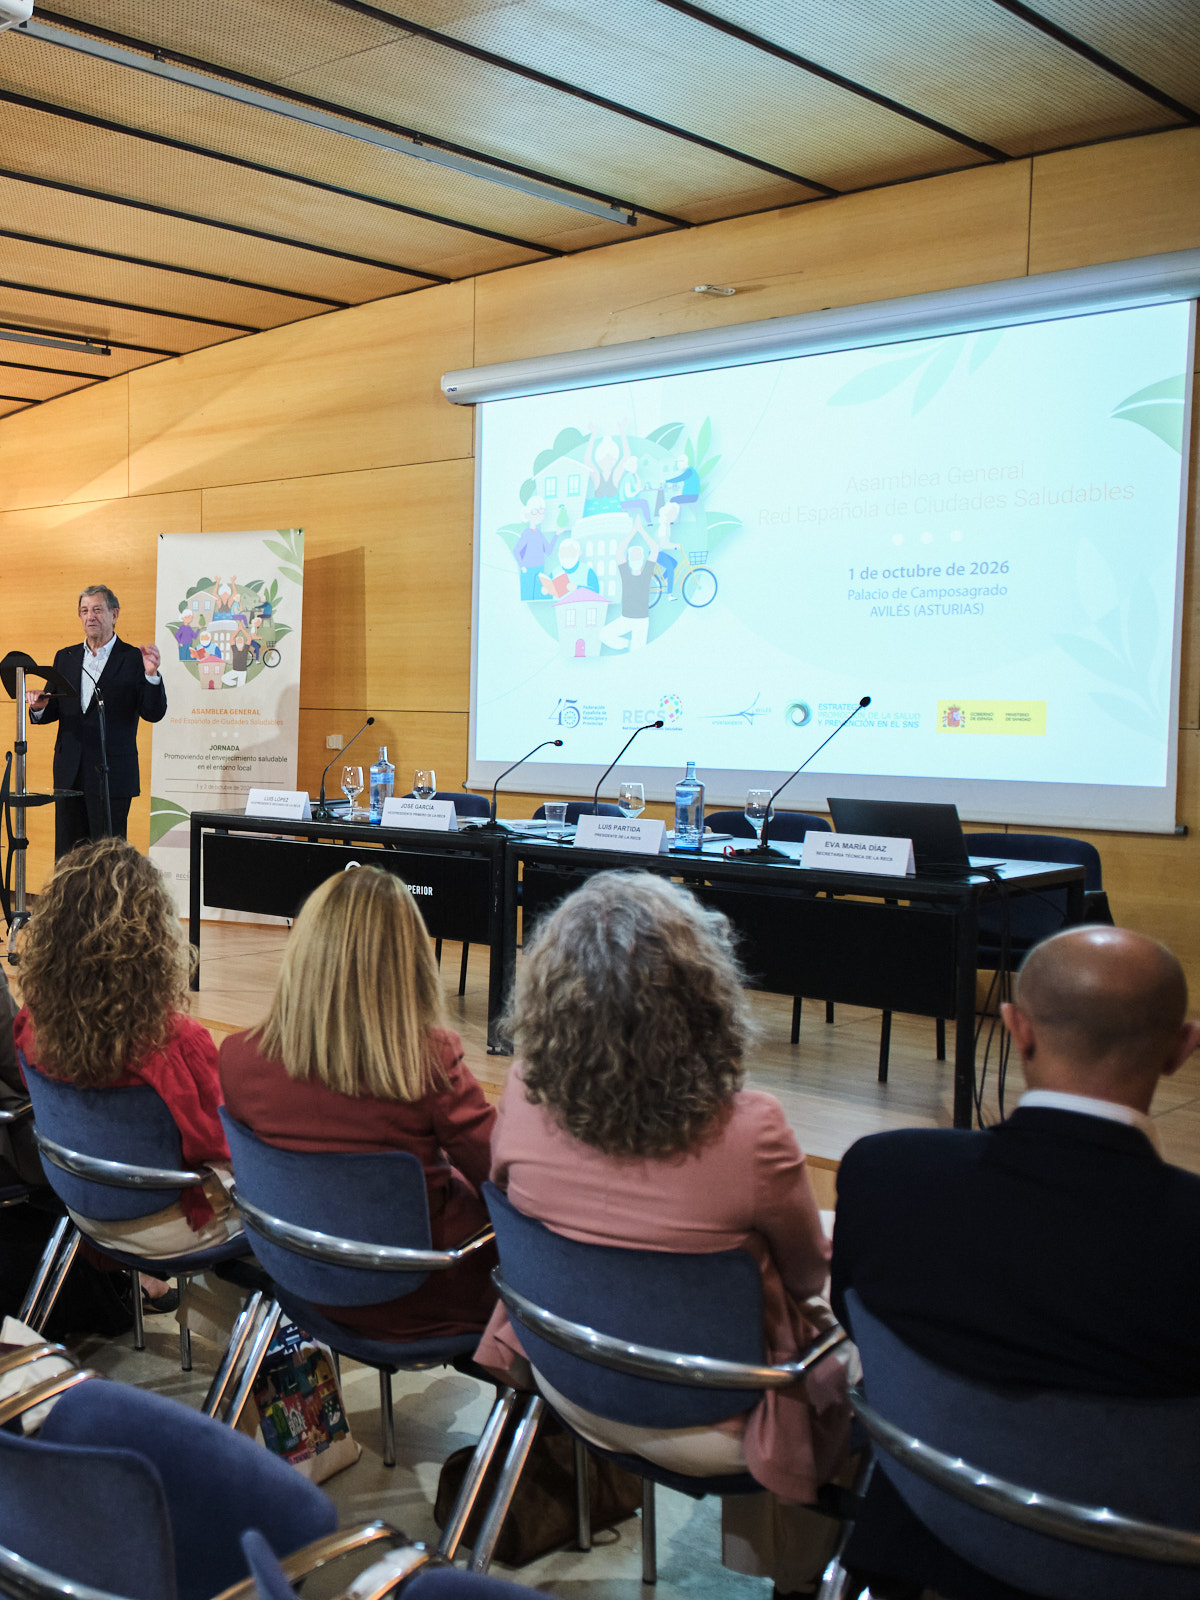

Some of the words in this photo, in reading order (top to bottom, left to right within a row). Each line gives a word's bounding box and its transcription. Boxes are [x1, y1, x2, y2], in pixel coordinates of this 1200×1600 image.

[847, 467, 940, 493] Asamblea
[947, 461, 1025, 485] General
[758, 505, 790, 526] Red
[797, 498, 879, 525] Española
[885, 498, 909, 517] de
[914, 491, 1007, 514] Ciudades
[1015, 481, 1135, 507] Saludables
[848, 568, 855, 580] 1
[860, 566, 878, 579] de
[882, 563, 941, 578] octubre
[945, 562, 966, 576] de
[970, 560, 1010, 575] 2026
[847, 588, 889, 600] Palacio
[892, 587, 907, 599] de
[910, 584, 1008, 599] Camposagrado
[869, 603, 911, 617] AVILÉS
[913, 602, 985, 617] (ASTURIAS)
[622, 710, 666, 723] RECS
[902, 721, 920, 729] SNS
[164, 752, 204, 761] Promoviendo
[211, 755, 257, 763] envejecimiento
[258, 755, 288, 763] saludable
[237, 764, 252, 772] local
[613, 825, 641, 833] PARTIDA
[842, 842, 867, 850] MARÍA
[869, 843, 887, 852] DÍAZ
